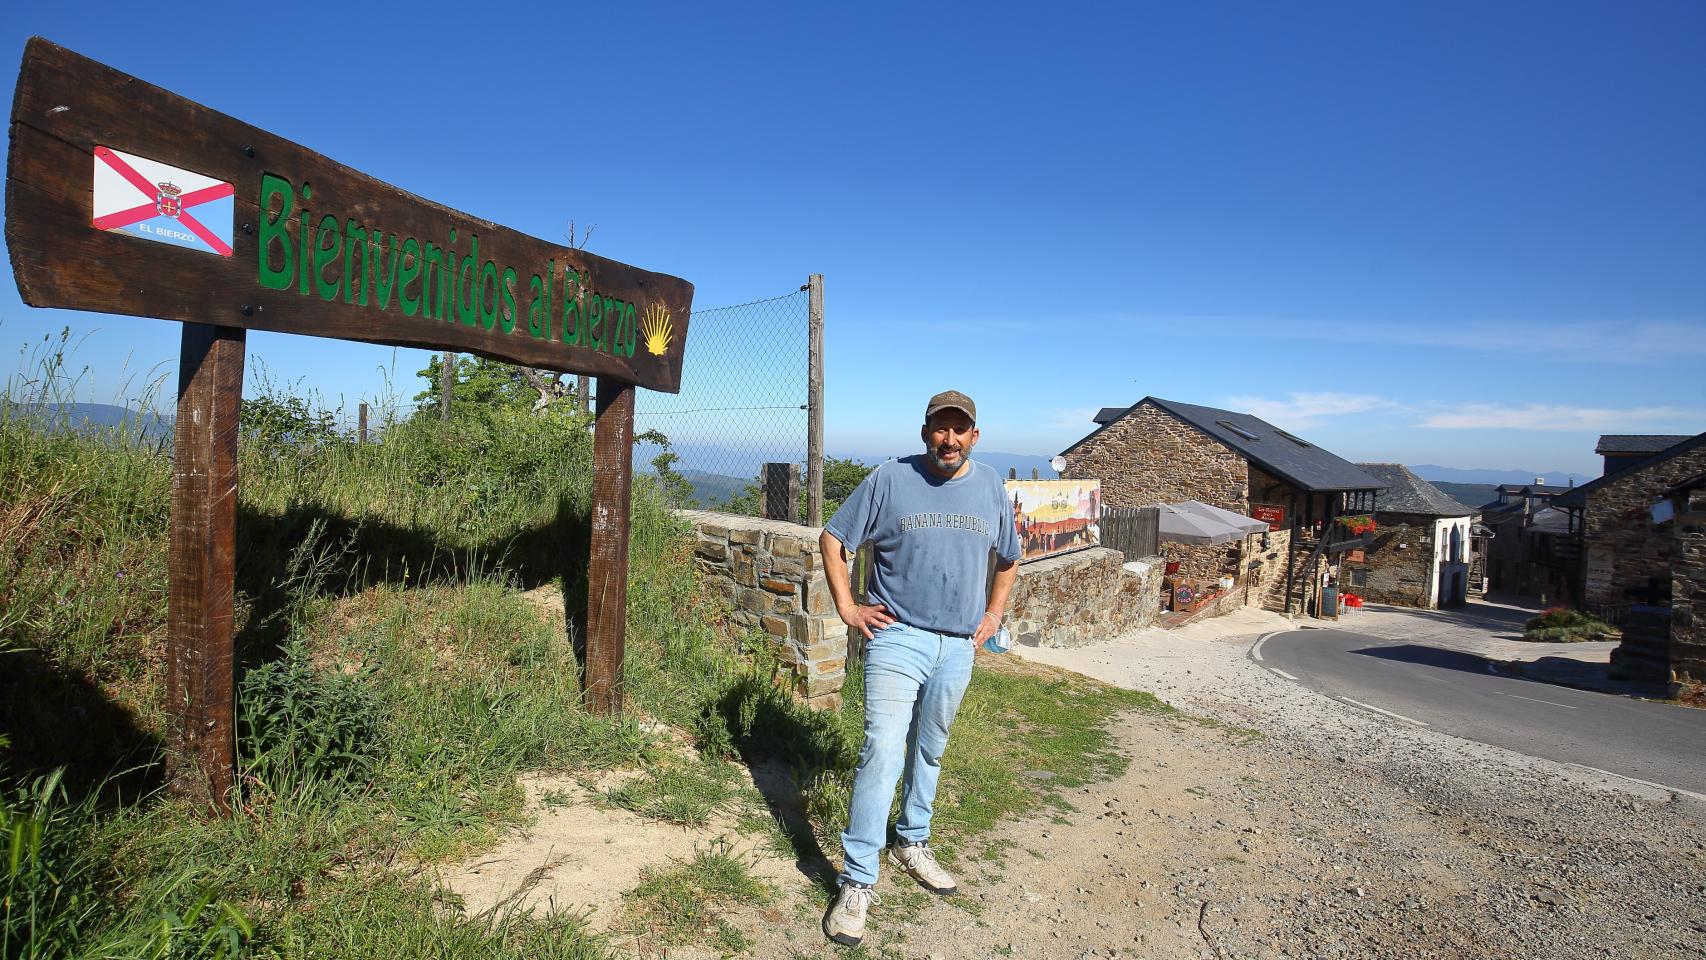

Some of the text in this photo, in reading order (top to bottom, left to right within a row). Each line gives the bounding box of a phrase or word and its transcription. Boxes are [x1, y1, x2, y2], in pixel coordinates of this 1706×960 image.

[139, 223, 195, 242] EL BIERZO
[257, 171, 637, 358] Bienvenidos al Bierzo
[900, 513, 943, 533] BANANA
